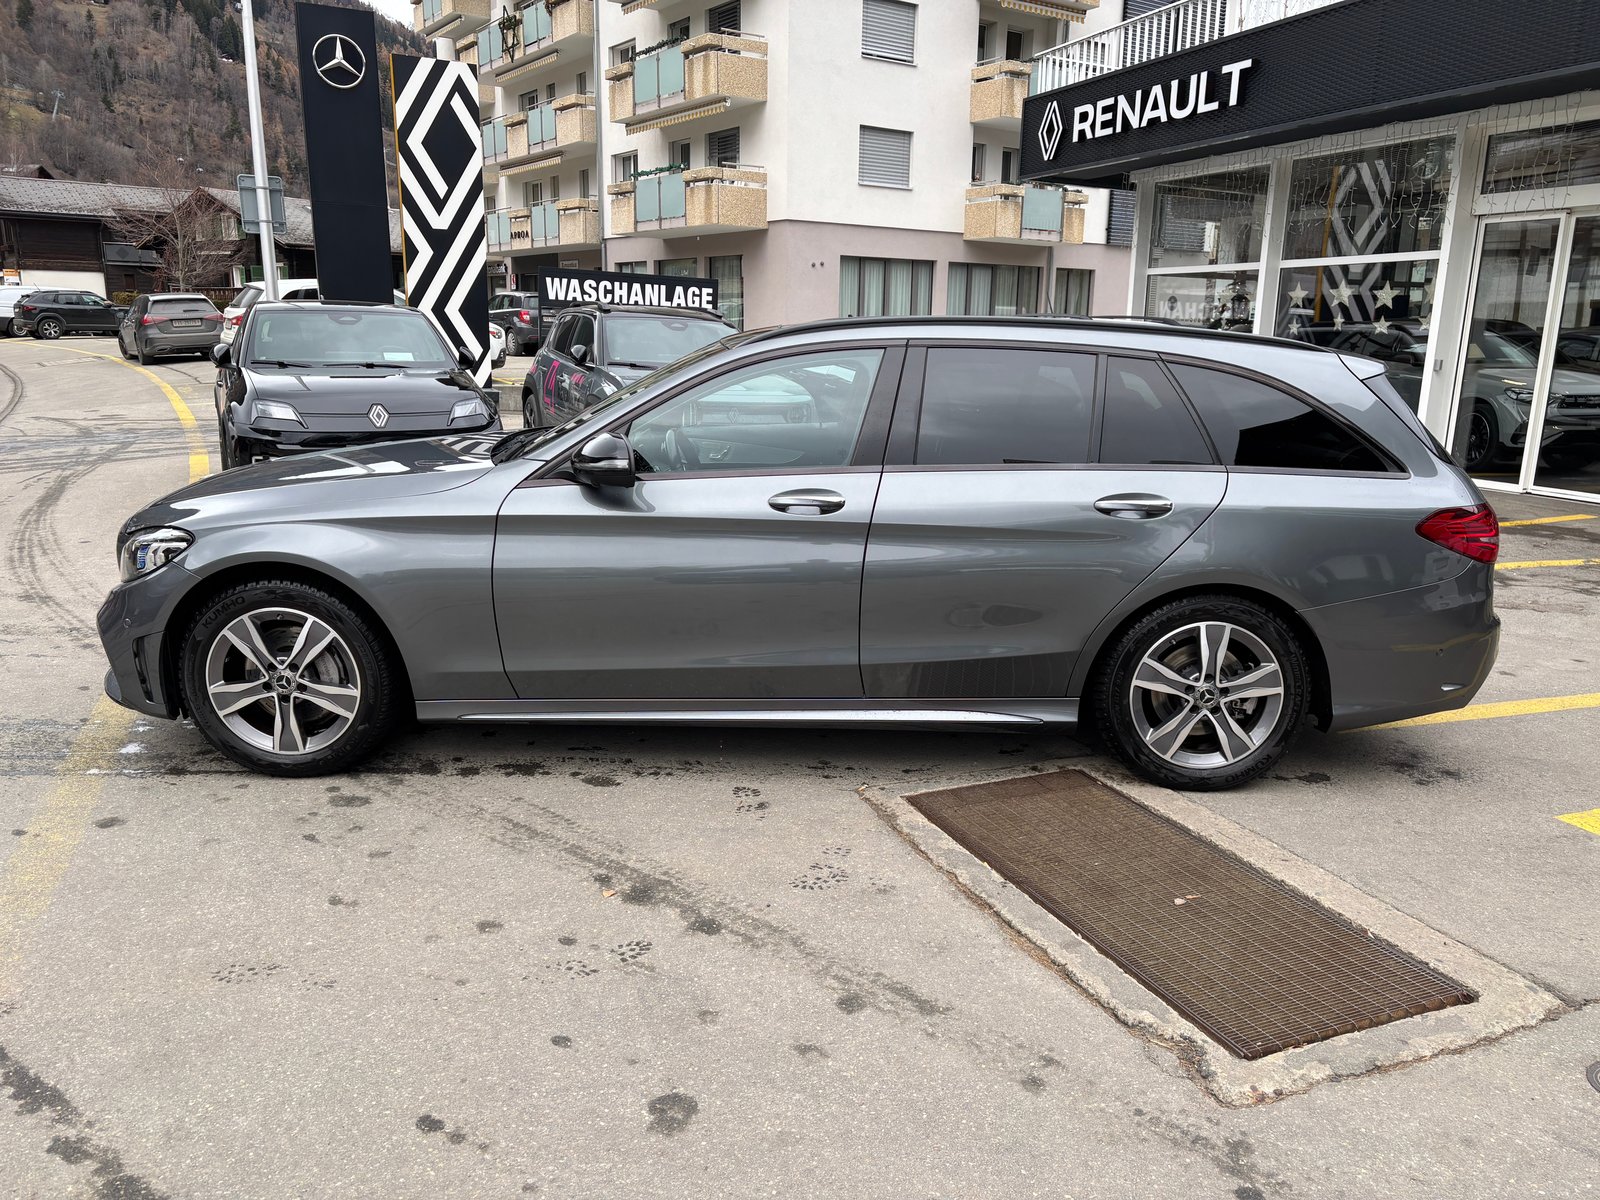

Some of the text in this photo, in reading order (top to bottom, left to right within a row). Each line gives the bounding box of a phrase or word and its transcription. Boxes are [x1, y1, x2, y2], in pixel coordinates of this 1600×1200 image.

[1072, 58, 1253, 143] RENAULT
[545, 277, 713, 309] WASCHANLAGE
[201, 596, 245, 629] KUMHO
[1225, 754, 1272, 783] KUMHO
